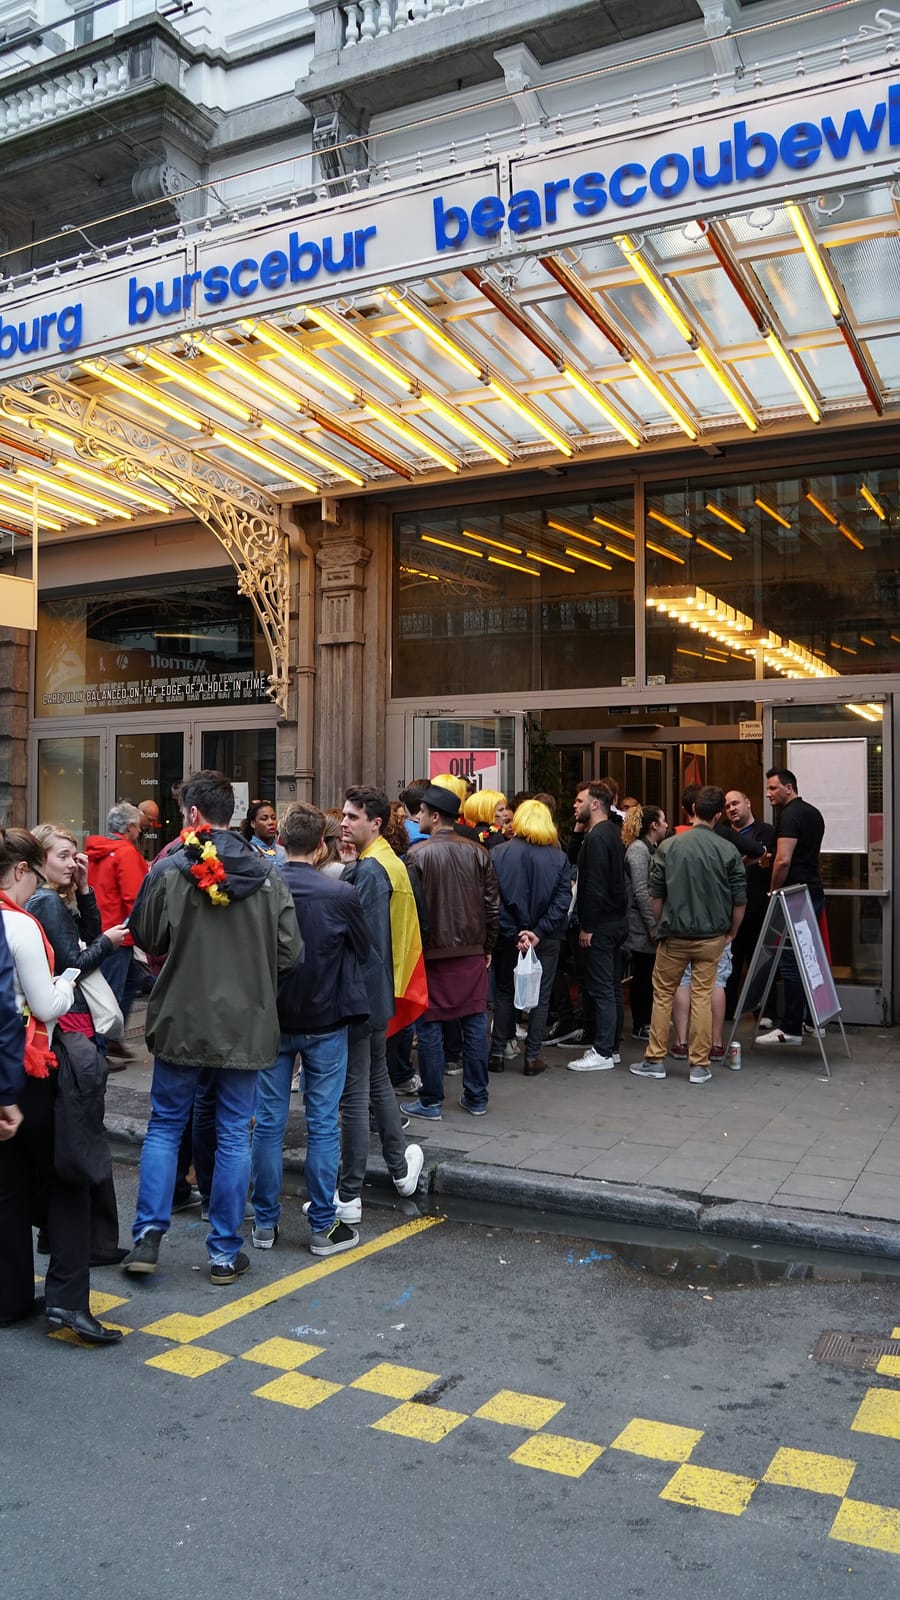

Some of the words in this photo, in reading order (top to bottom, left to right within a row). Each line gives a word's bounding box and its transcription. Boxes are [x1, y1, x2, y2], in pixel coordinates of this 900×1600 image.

[128, 225, 376, 325] burscebur
[42, 690, 84, 705] CAREFULLY
[86, 688, 127, 701] BALANCED
[129, 687, 140, 697] ON
[144, 685, 158, 697] THE
[161, 684, 181, 696] EDGE
[185, 683, 195, 694] OF
[199, 683, 204, 693] A
[207, 681, 229, 693] HOLE
[233, 680, 240, 690] IN
[246, 677, 265, 689] TIME
[449, 752, 476, 777] out
